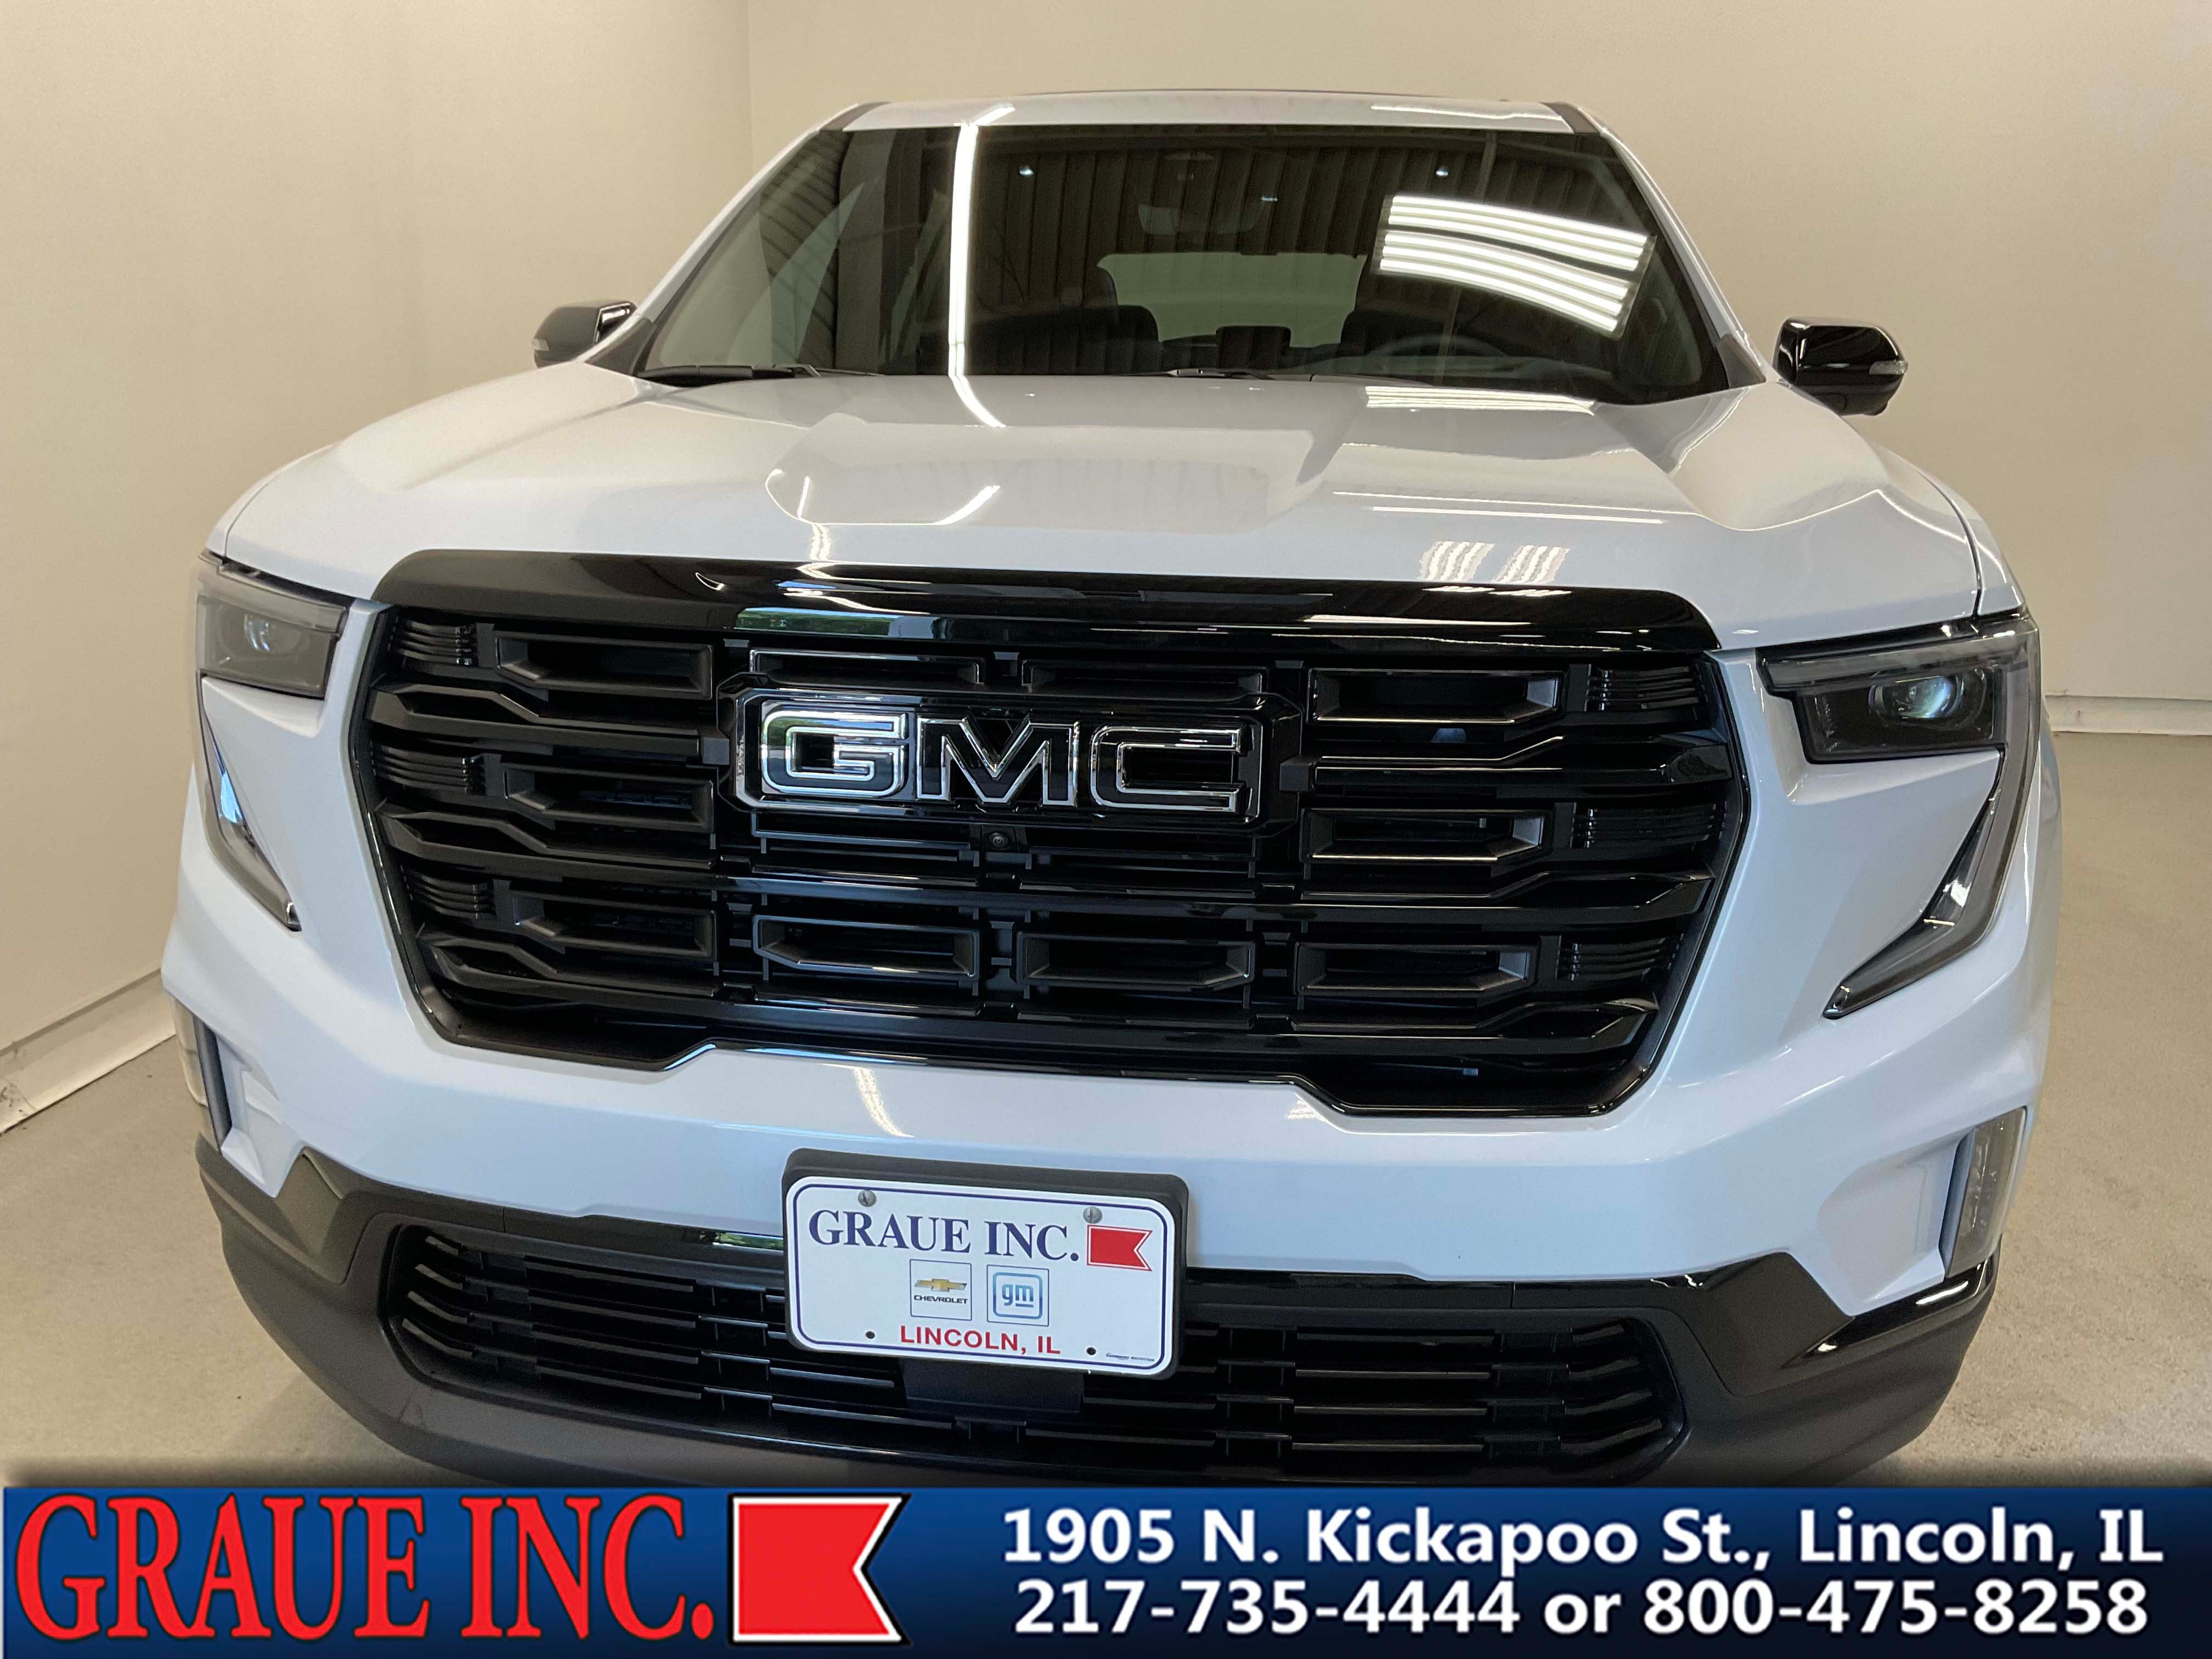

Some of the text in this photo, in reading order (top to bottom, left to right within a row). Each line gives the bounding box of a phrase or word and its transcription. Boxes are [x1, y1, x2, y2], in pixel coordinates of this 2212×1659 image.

[761, 701, 1246, 814] GMC
[809, 1210, 1079, 1262] GRAUE INC.
[913, 1294, 968, 1305] CHEVROLET
[1001, 1283, 1034, 1308] gm
[900, 1325, 1060, 1355] LINCOLN, IL
